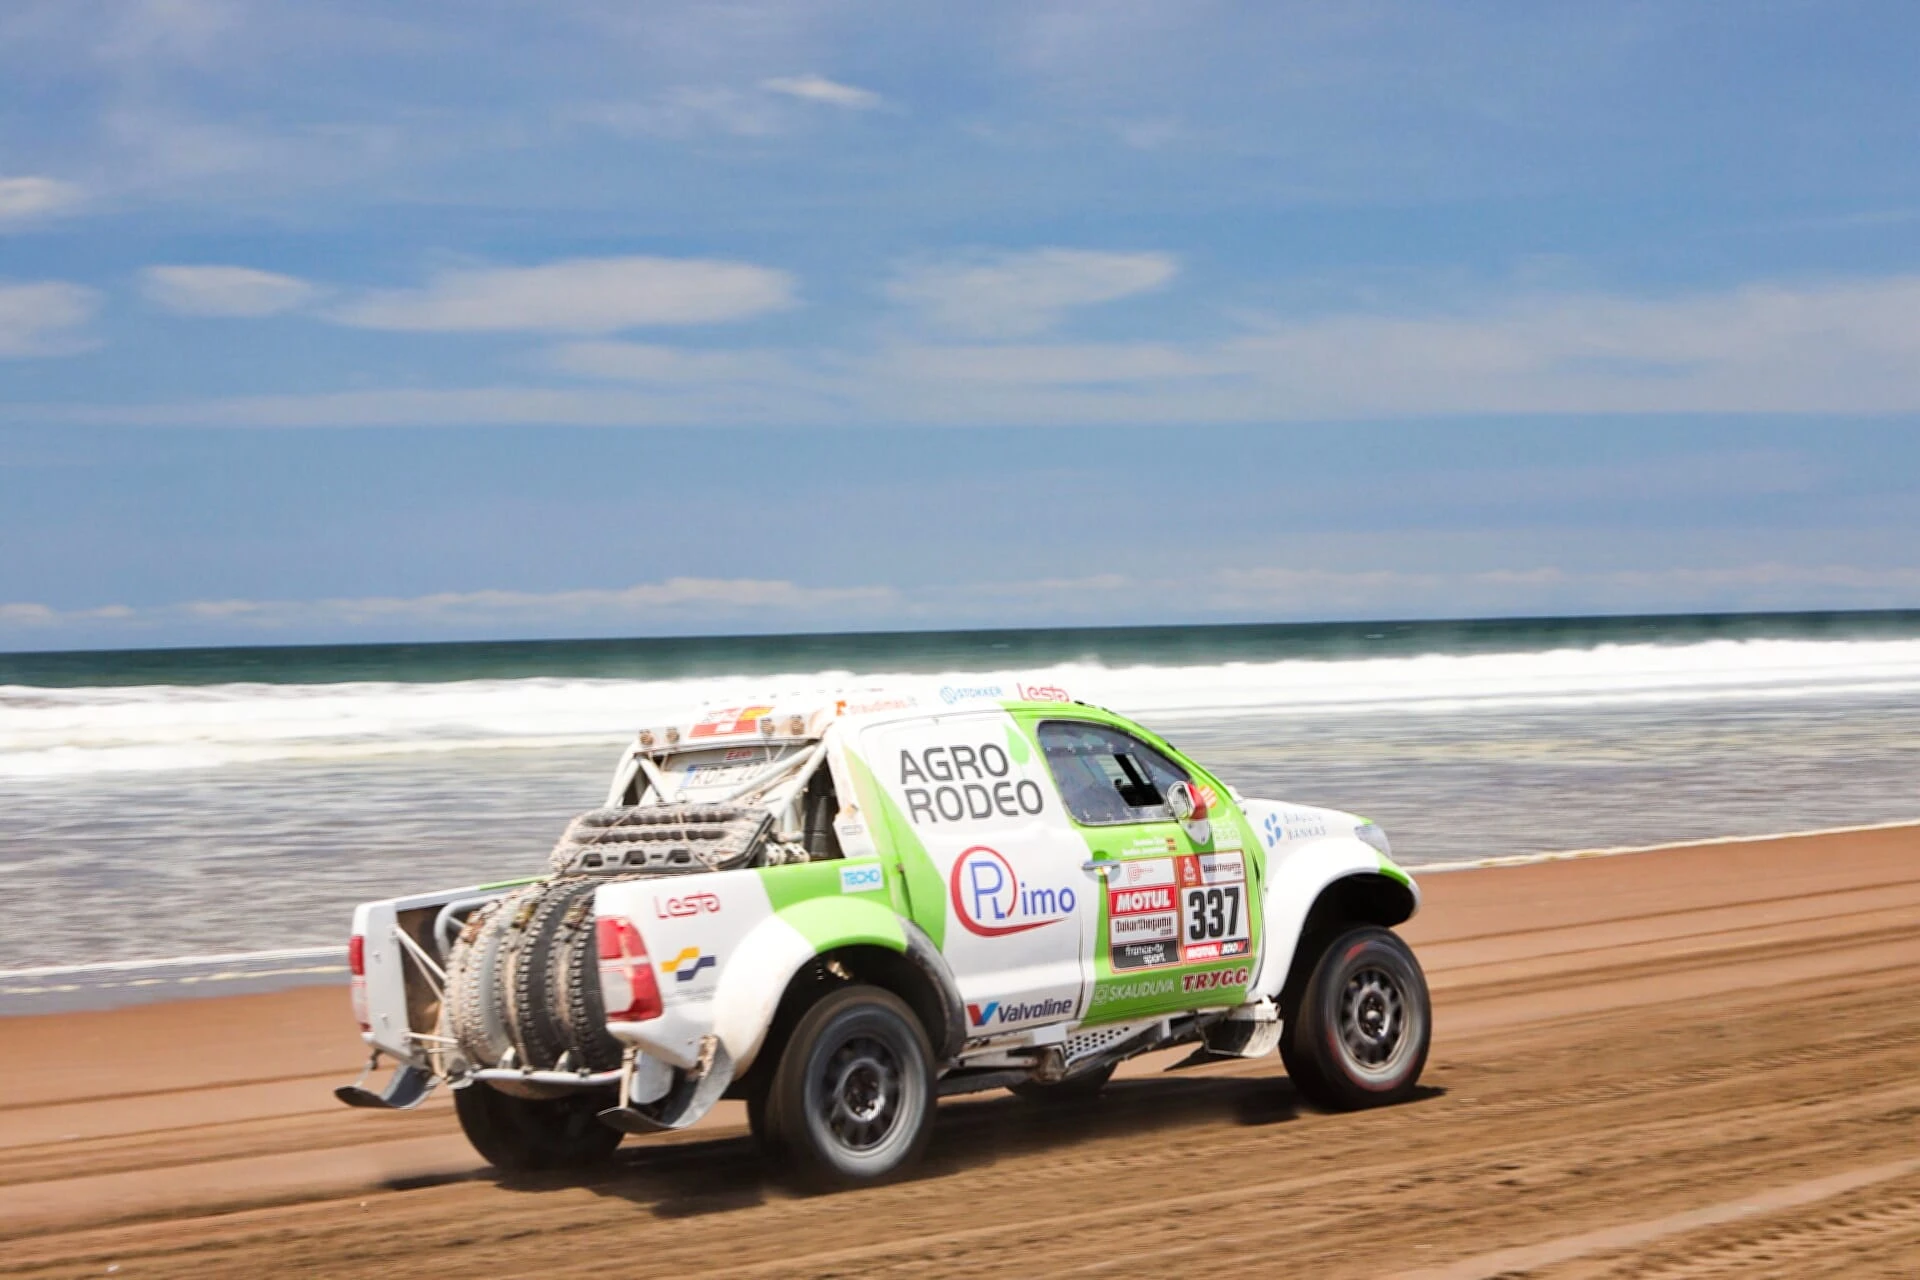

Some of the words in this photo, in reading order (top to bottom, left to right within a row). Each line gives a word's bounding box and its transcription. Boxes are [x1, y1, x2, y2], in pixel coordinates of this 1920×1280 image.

[900, 743, 1009, 785] AGRO
[904, 779, 1043, 825] RODEO
[654, 890, 721, 919] Lesta
[1116, 889, 1171, 912] MOTUL
[1188, 887, 1240, 941] 337
[1110, 979, 1174, 1000] SKAUDUVA
[1183, 967, 1249, 993] TRYGG
[999, 998, 1073, 1024] Valvoline
